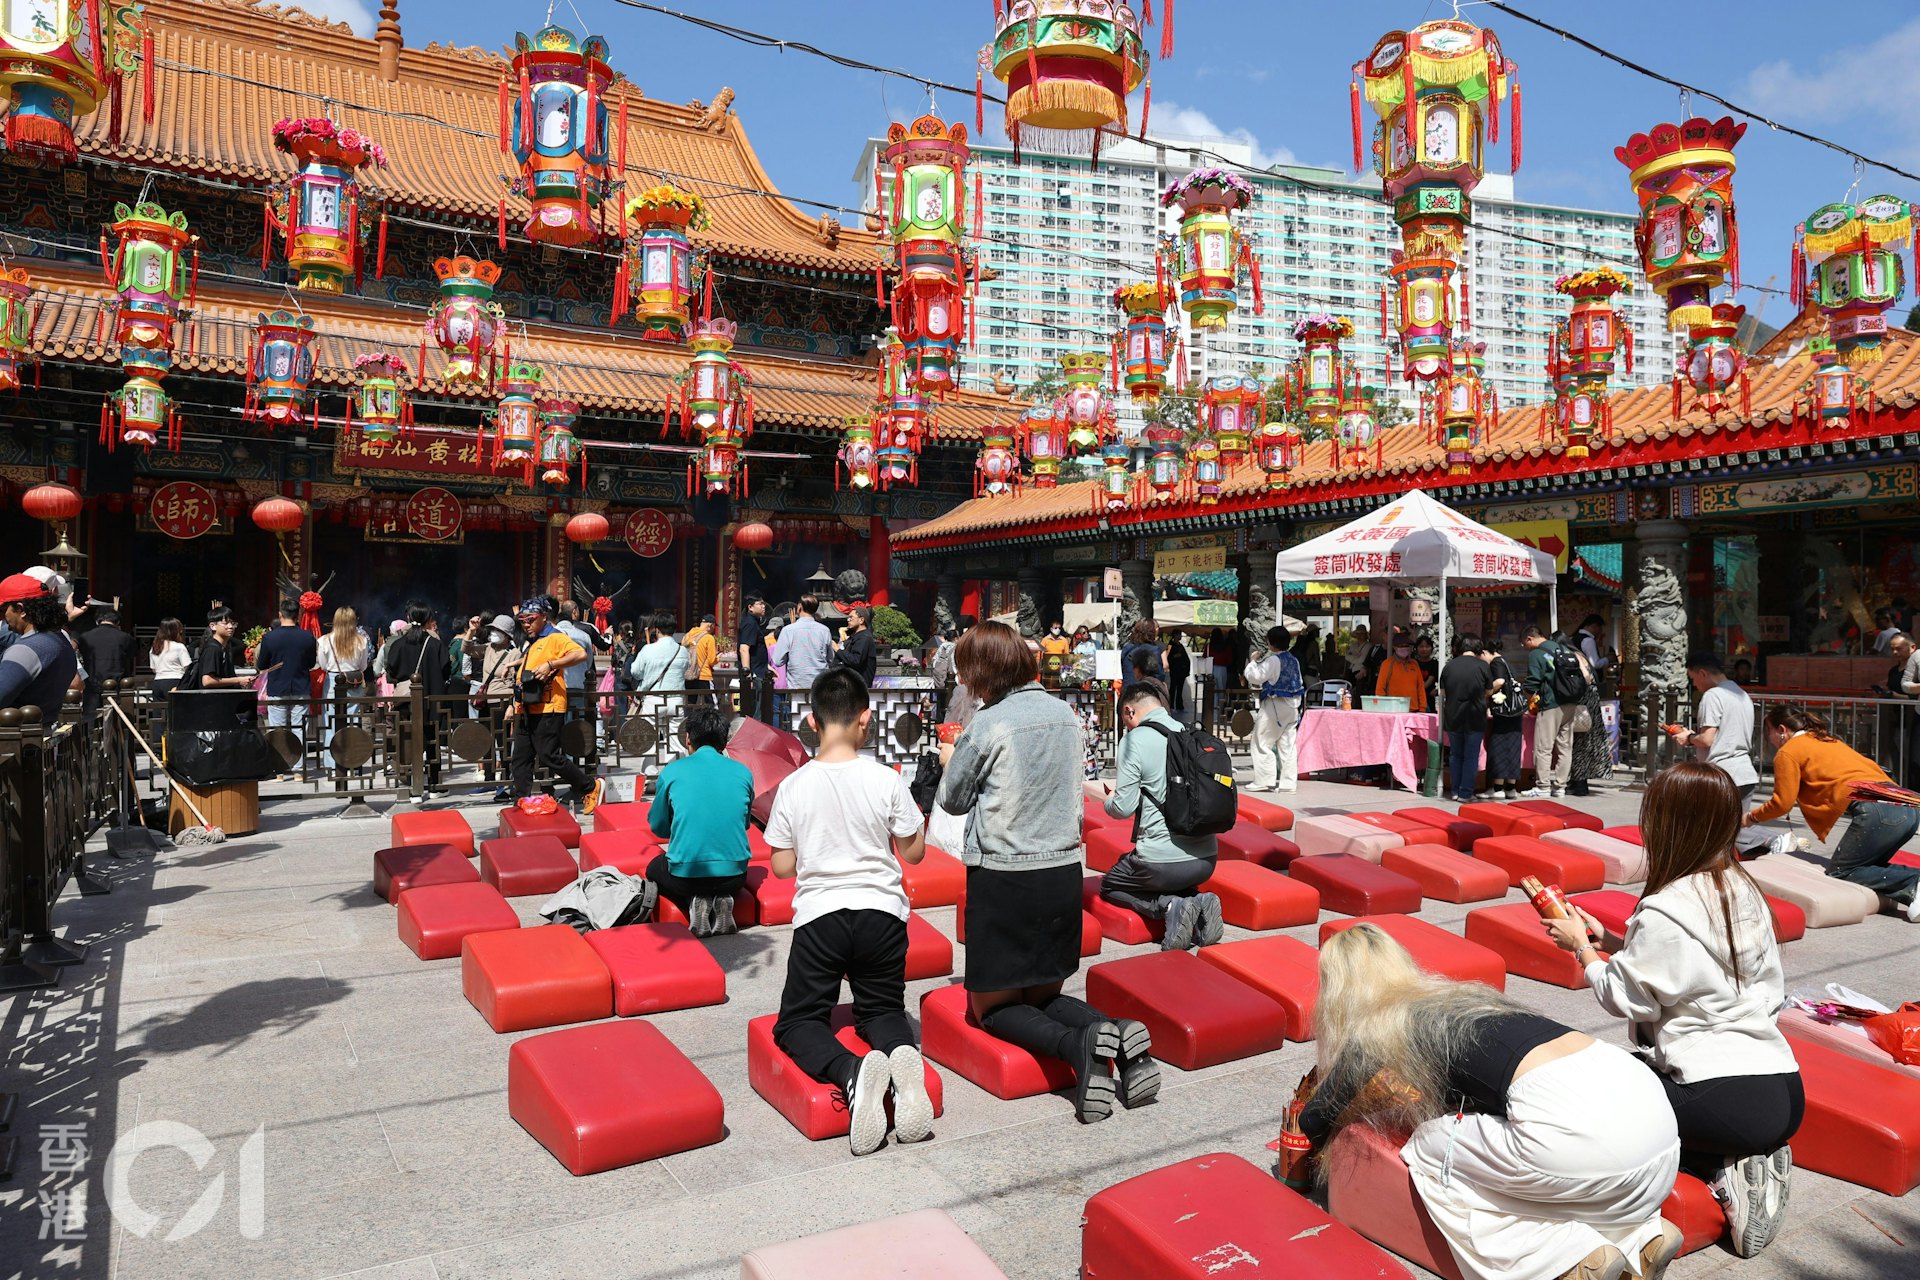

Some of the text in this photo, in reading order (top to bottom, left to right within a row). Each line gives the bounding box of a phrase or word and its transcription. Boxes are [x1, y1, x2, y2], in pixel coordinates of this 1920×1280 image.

[166, 493, 199, 526] 師
[418, 498, 449, 530] 道
[635, 520, 661, 547] 經
[1157, 552, 1224, 569] 出口 不能折返
[1314, 552, 1402, 576] 簽筒收發處
[1473, 552, 1533, 578] 簽筒收發處
